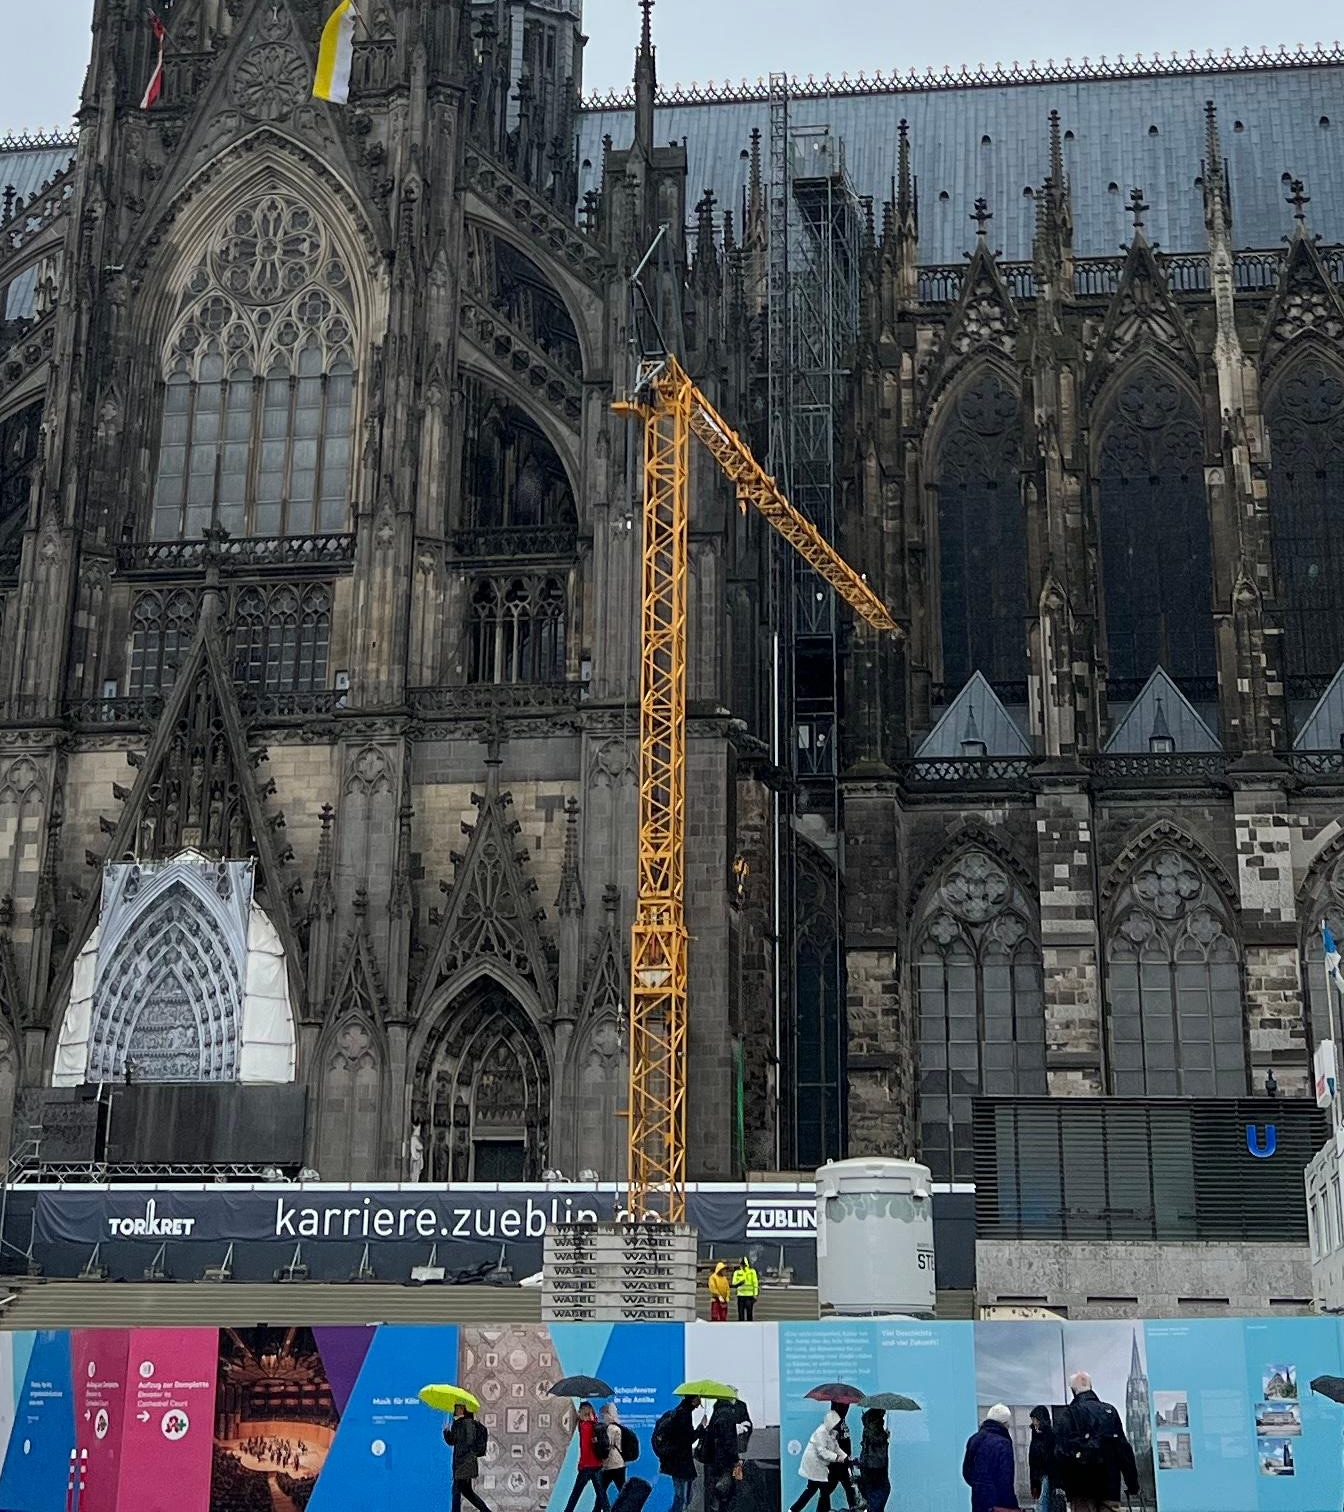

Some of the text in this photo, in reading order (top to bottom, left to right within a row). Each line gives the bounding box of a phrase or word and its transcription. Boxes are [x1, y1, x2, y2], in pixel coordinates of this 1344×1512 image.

[1247, 1124, 1276, 1157] U
[108, 1198, 195, 1236] TORKRET
[276, 1198, 661, 1237] karriere.zueblin
[747, 1210, 816, 1228] ZÜBLIN
